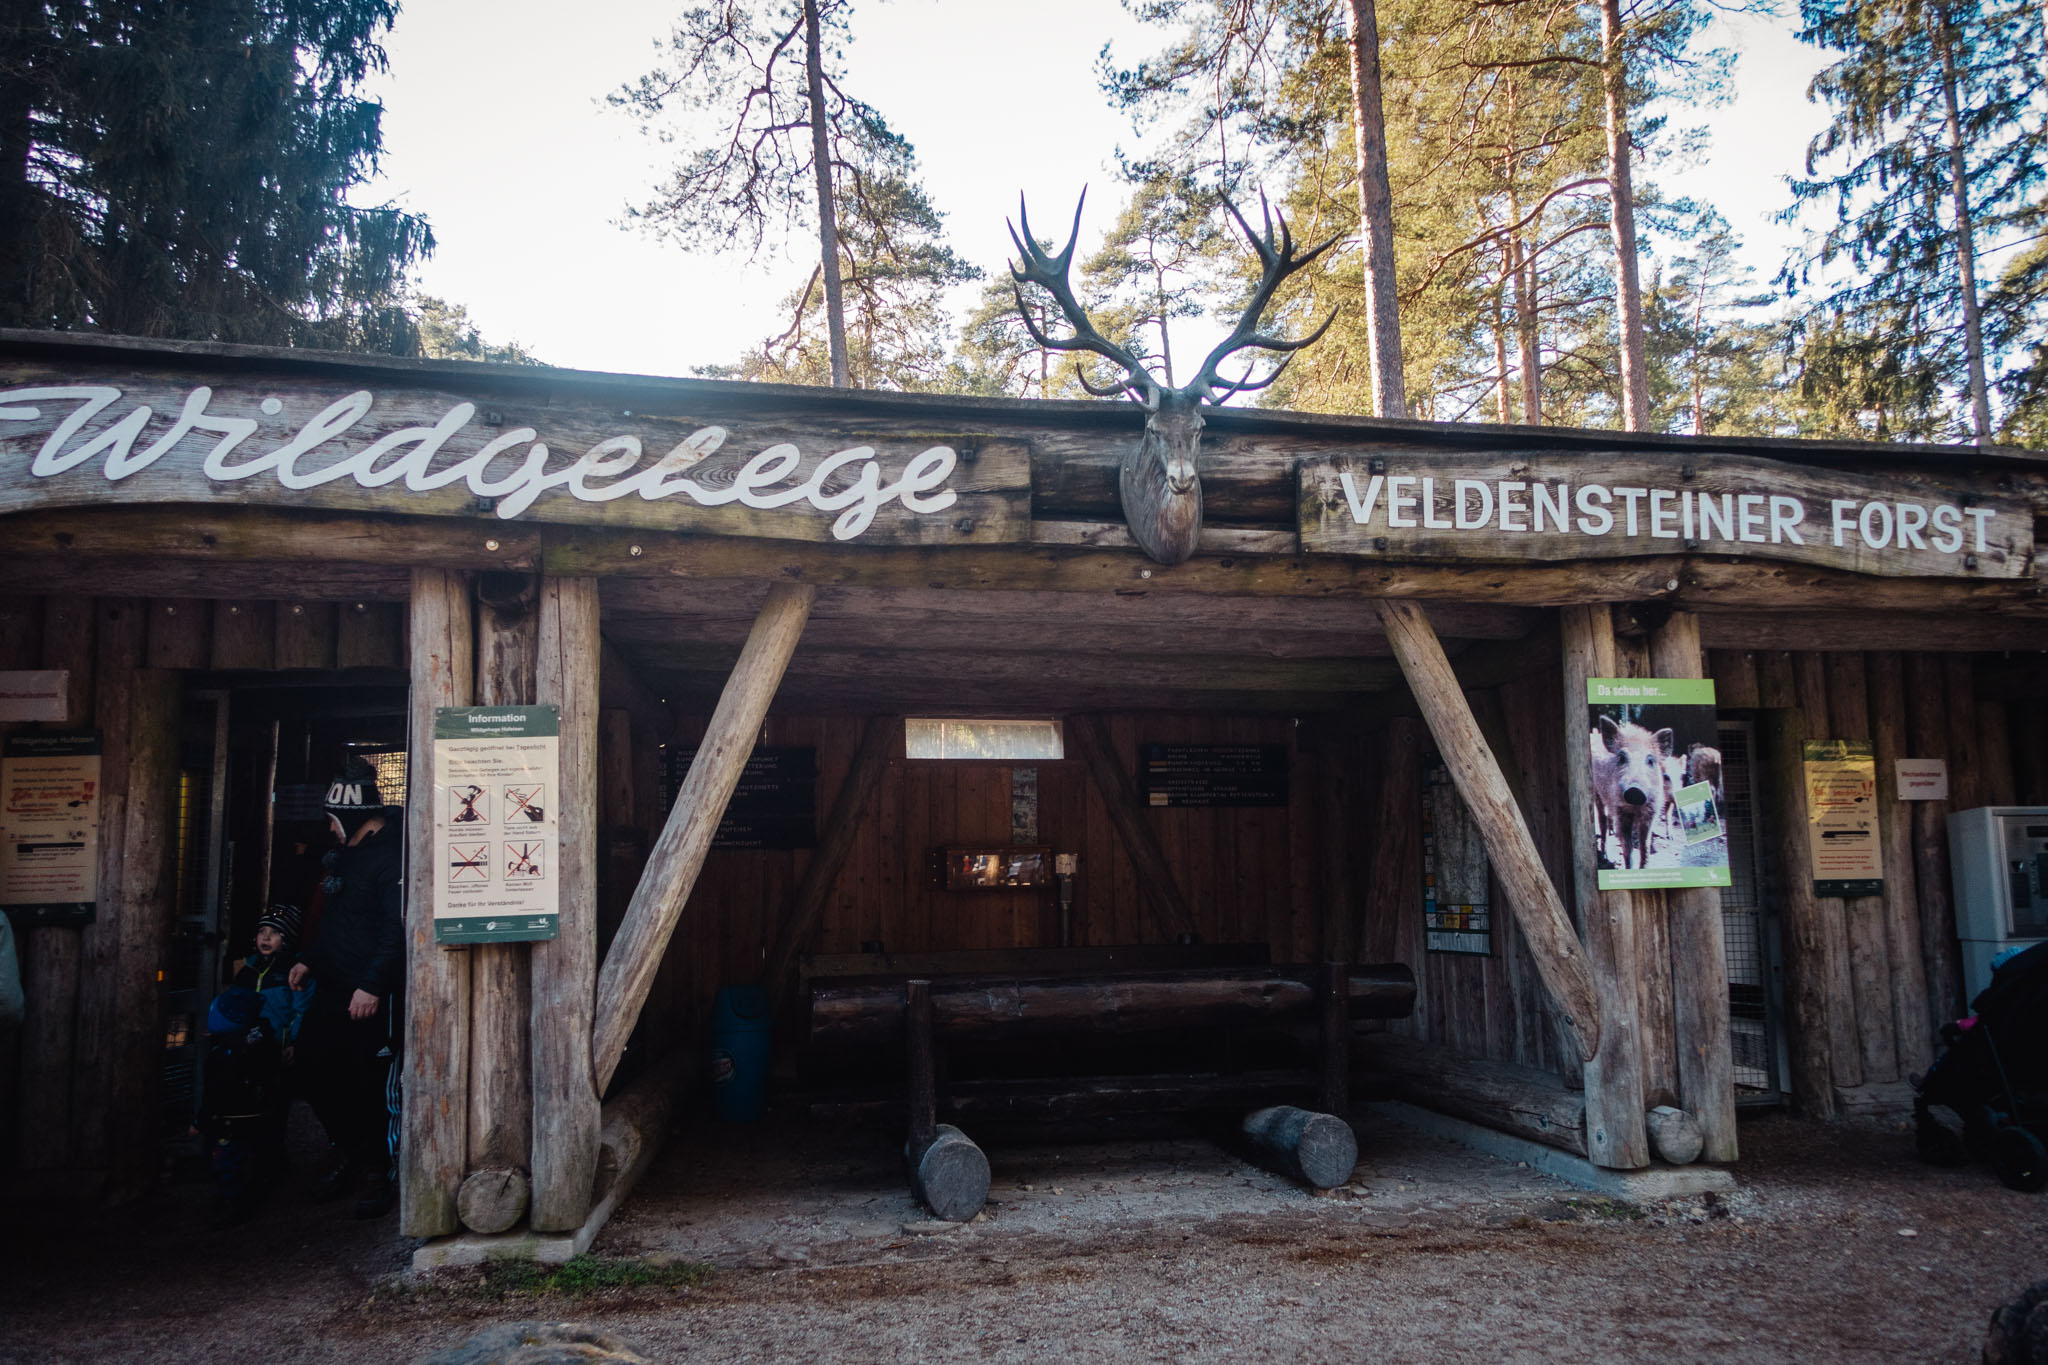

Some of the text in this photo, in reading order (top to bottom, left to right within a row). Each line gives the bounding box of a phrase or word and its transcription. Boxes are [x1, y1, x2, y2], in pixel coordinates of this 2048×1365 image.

[0, 386, 957, 540] Wildgehege
[1340, 473, 1996, 554] VELDENSTEINER FORST
[1598, 684, 1611, 696] Da
[1613, 684, 1640, 696] schau
[468, 713, 527, 724] Information
